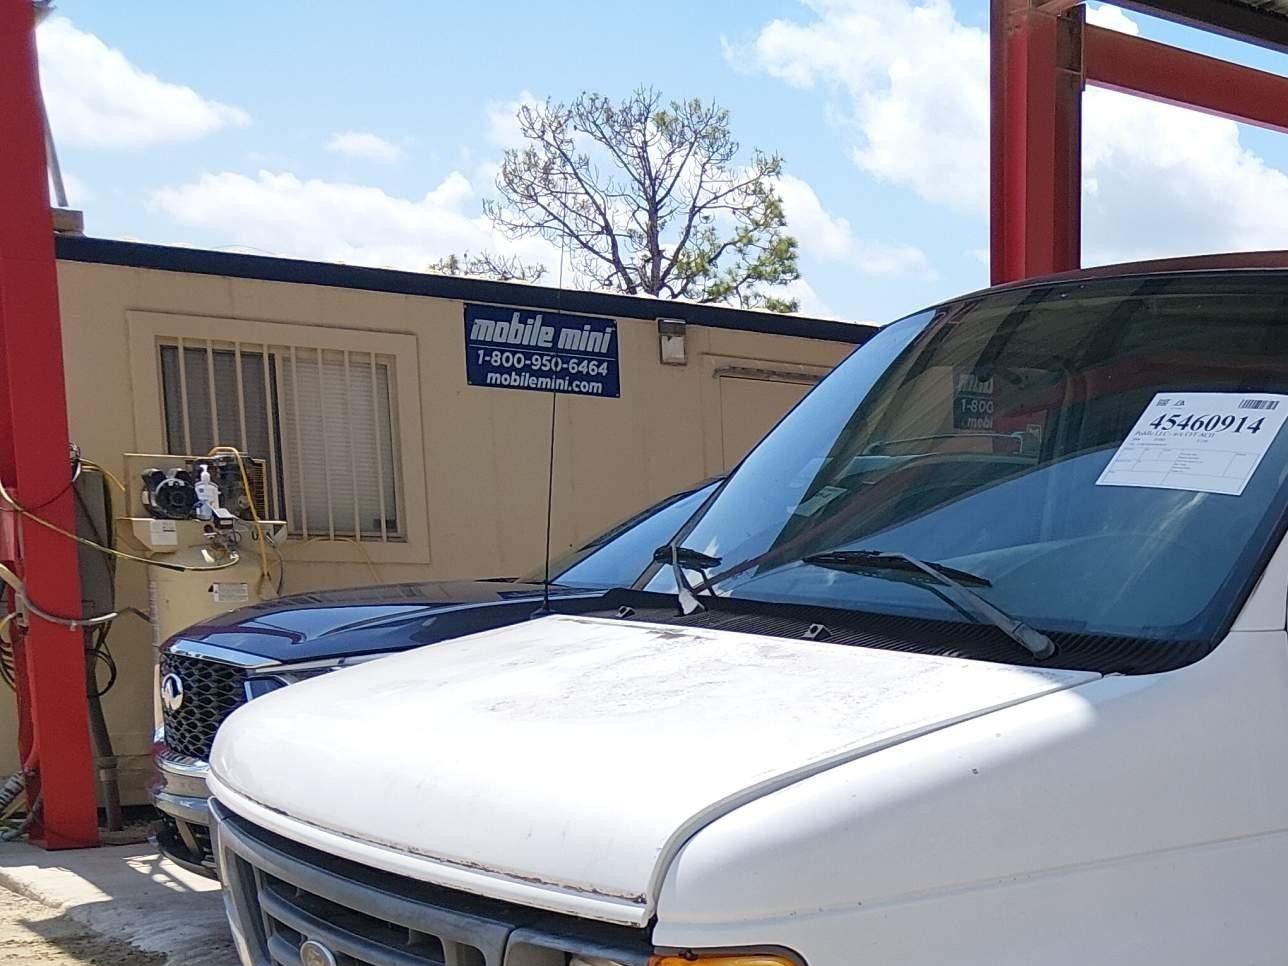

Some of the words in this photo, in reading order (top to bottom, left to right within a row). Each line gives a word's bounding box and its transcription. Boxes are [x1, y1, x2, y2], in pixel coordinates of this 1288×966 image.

[470, 312, 555, 348] mobile
[557, 324, 613, 354] mini
[477, 349, 608, 377] 1-800-950-6464
[486, 372, 603, 394] mobilemini.com
[1149, 413, 1266, 434] 45460914
